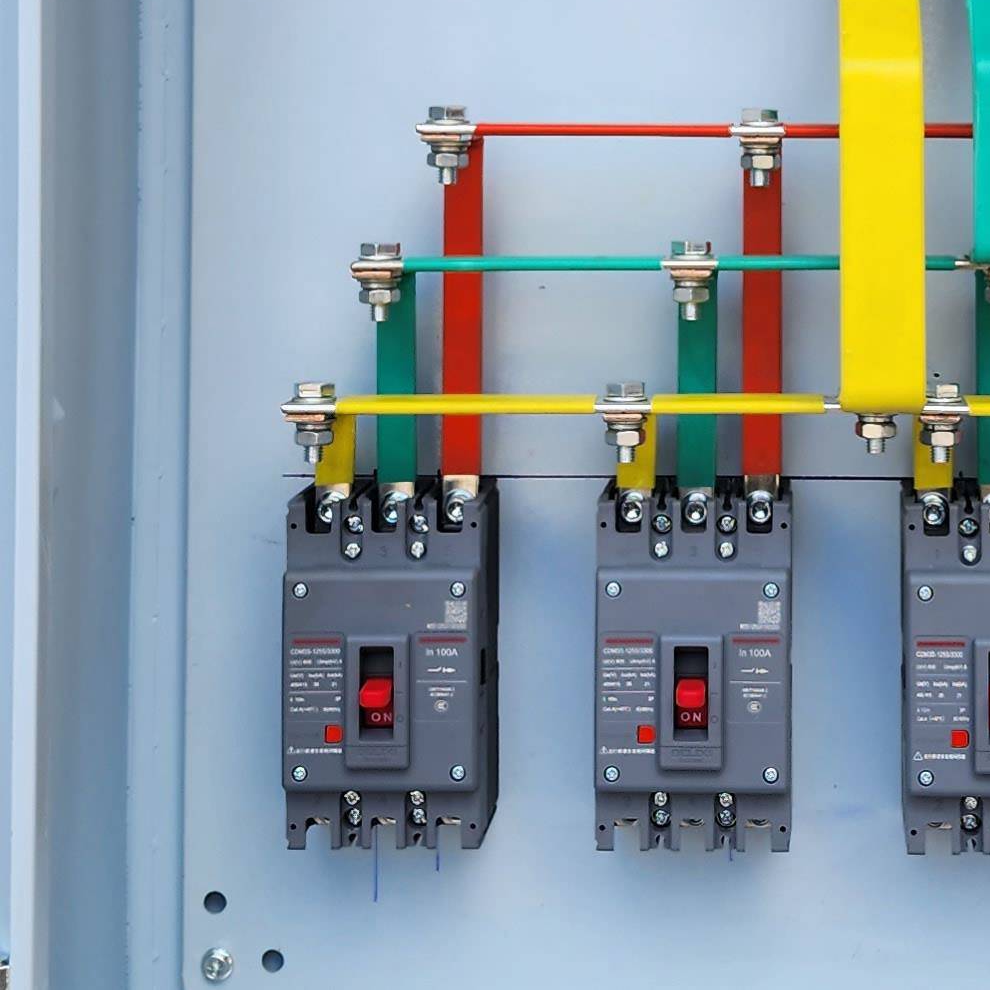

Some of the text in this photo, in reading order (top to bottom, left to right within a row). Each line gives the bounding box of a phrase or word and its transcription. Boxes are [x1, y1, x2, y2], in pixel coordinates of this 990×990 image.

[436, 648, 458, 656] 100A
[749, 649, 771, 657] 100A
[371, 712, 392, 722] ON
[680, 712, 702, 722] ON
